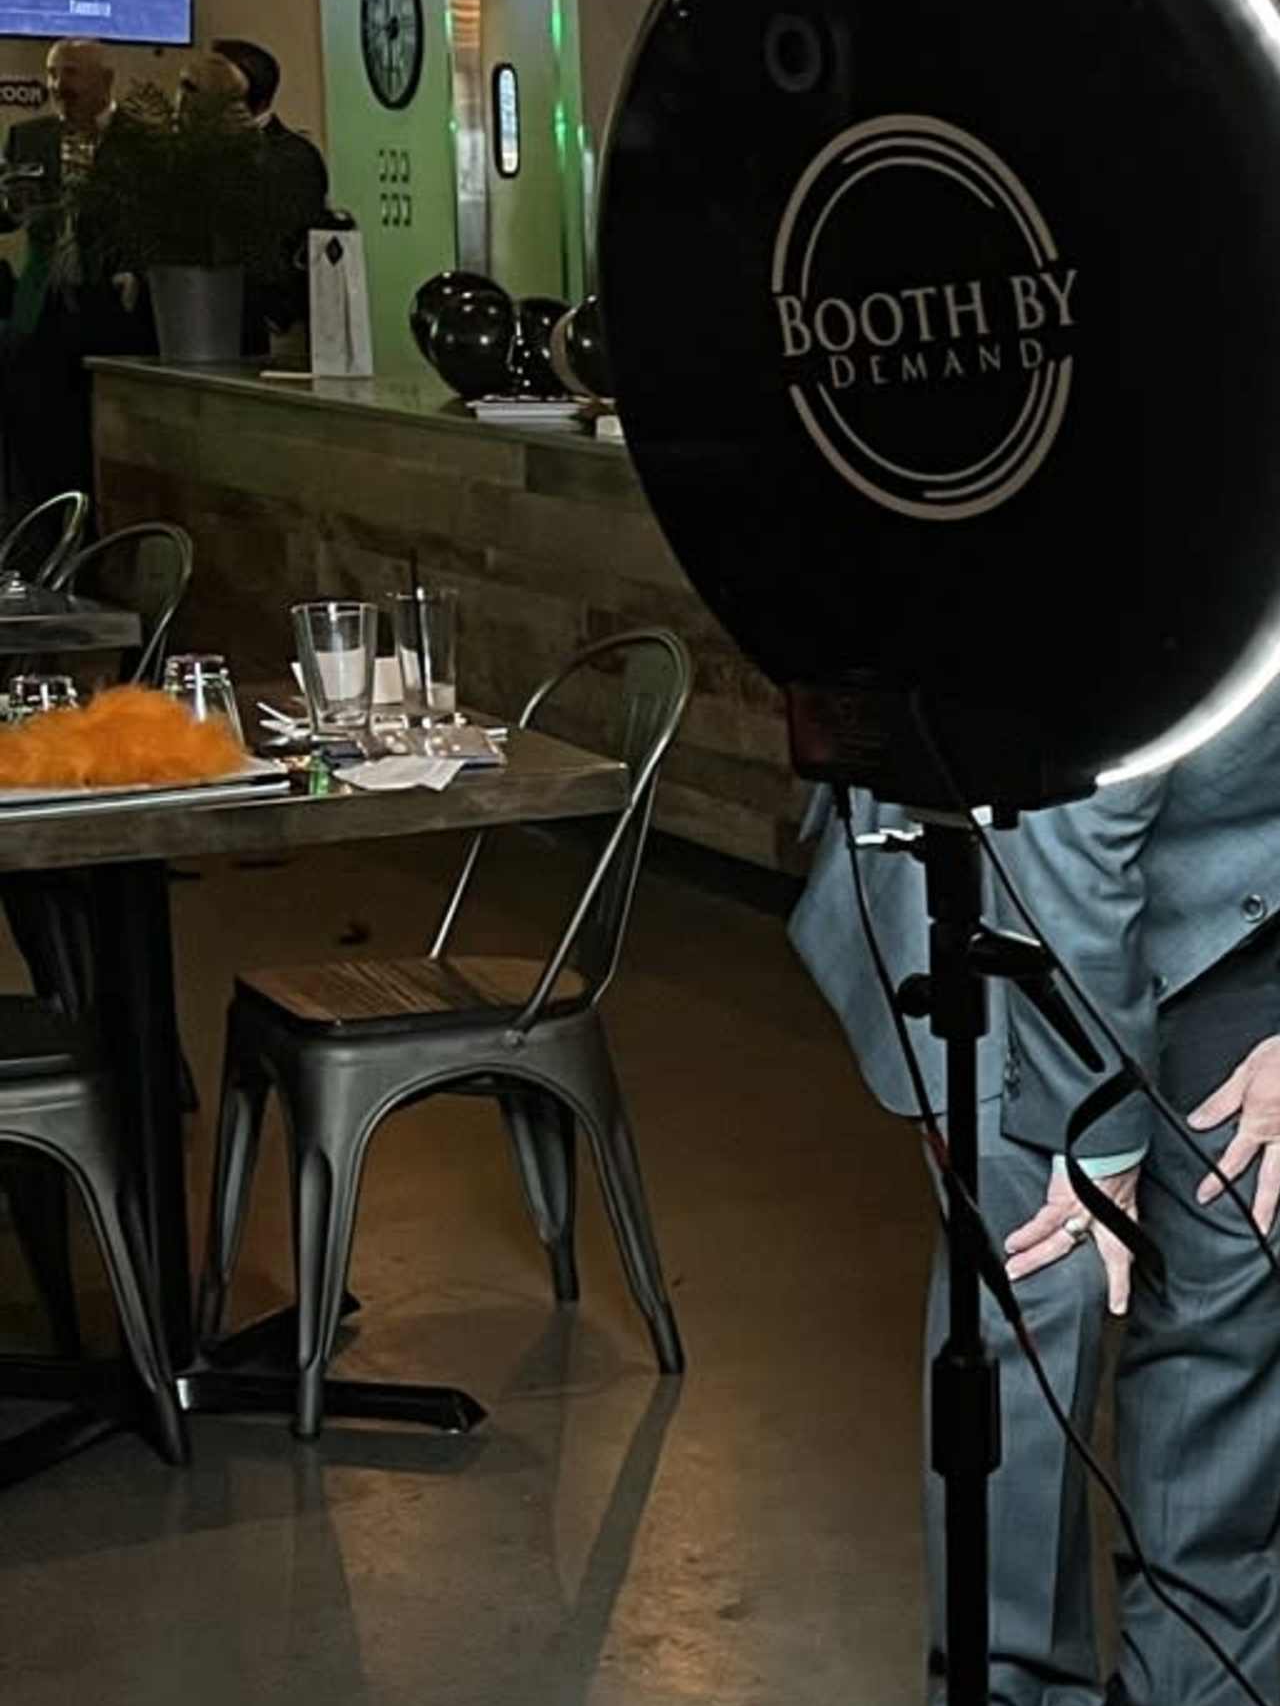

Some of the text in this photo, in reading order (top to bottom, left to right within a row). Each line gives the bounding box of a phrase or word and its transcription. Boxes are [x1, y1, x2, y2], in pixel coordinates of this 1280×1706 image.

[776, 269, 1078, 357] BOOTH BY
[830, 337, 1045, 390] DEMAND
